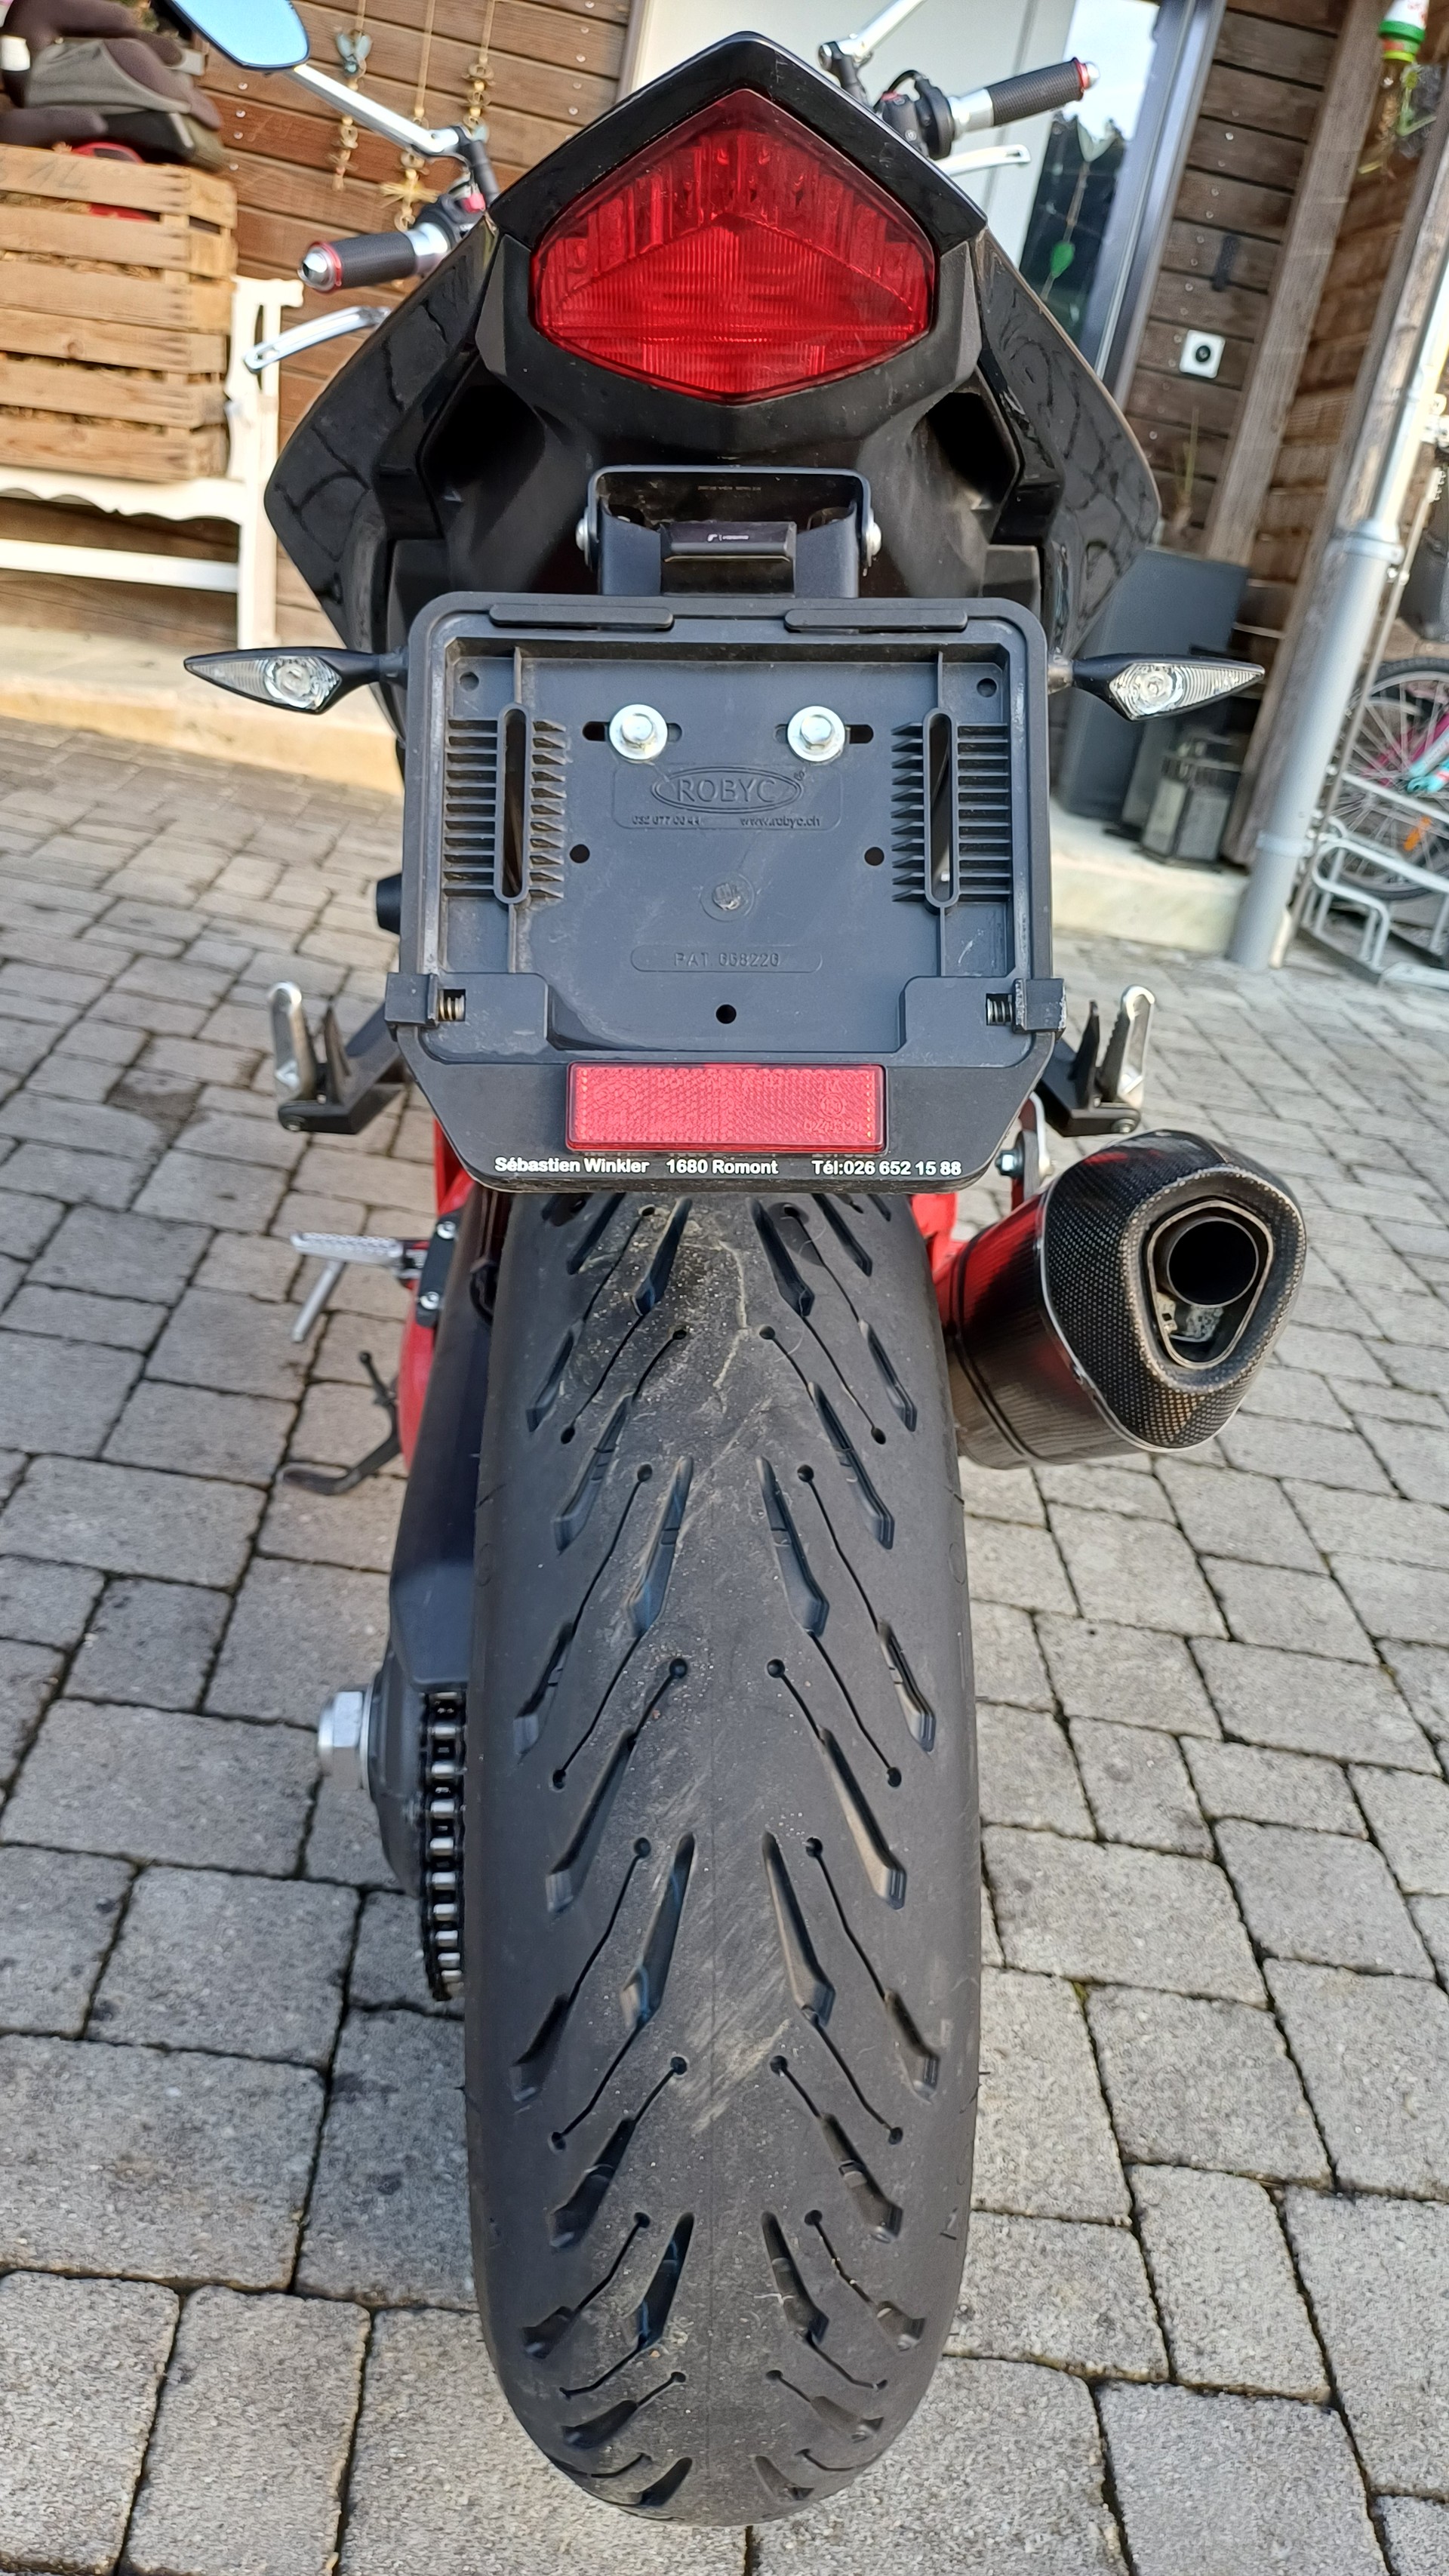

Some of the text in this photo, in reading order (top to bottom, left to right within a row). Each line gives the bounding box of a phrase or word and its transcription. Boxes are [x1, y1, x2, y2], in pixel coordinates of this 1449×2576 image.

[678, 778, 776, 802] ROBYC
[740, 815, 820, 829] www.robyc.ch
[494, 1156, 580, 1173] Sébastien
[583, 1158, 650, 1174] Winkler
[666, 1159, 708, 1174] 1680
[712, 1159, 779, 1174] Romont
[878, 1161, 912, 1175] 652
[915, 1161, 937, 1175] 15
[940, 1161, 961, 1176] 88
